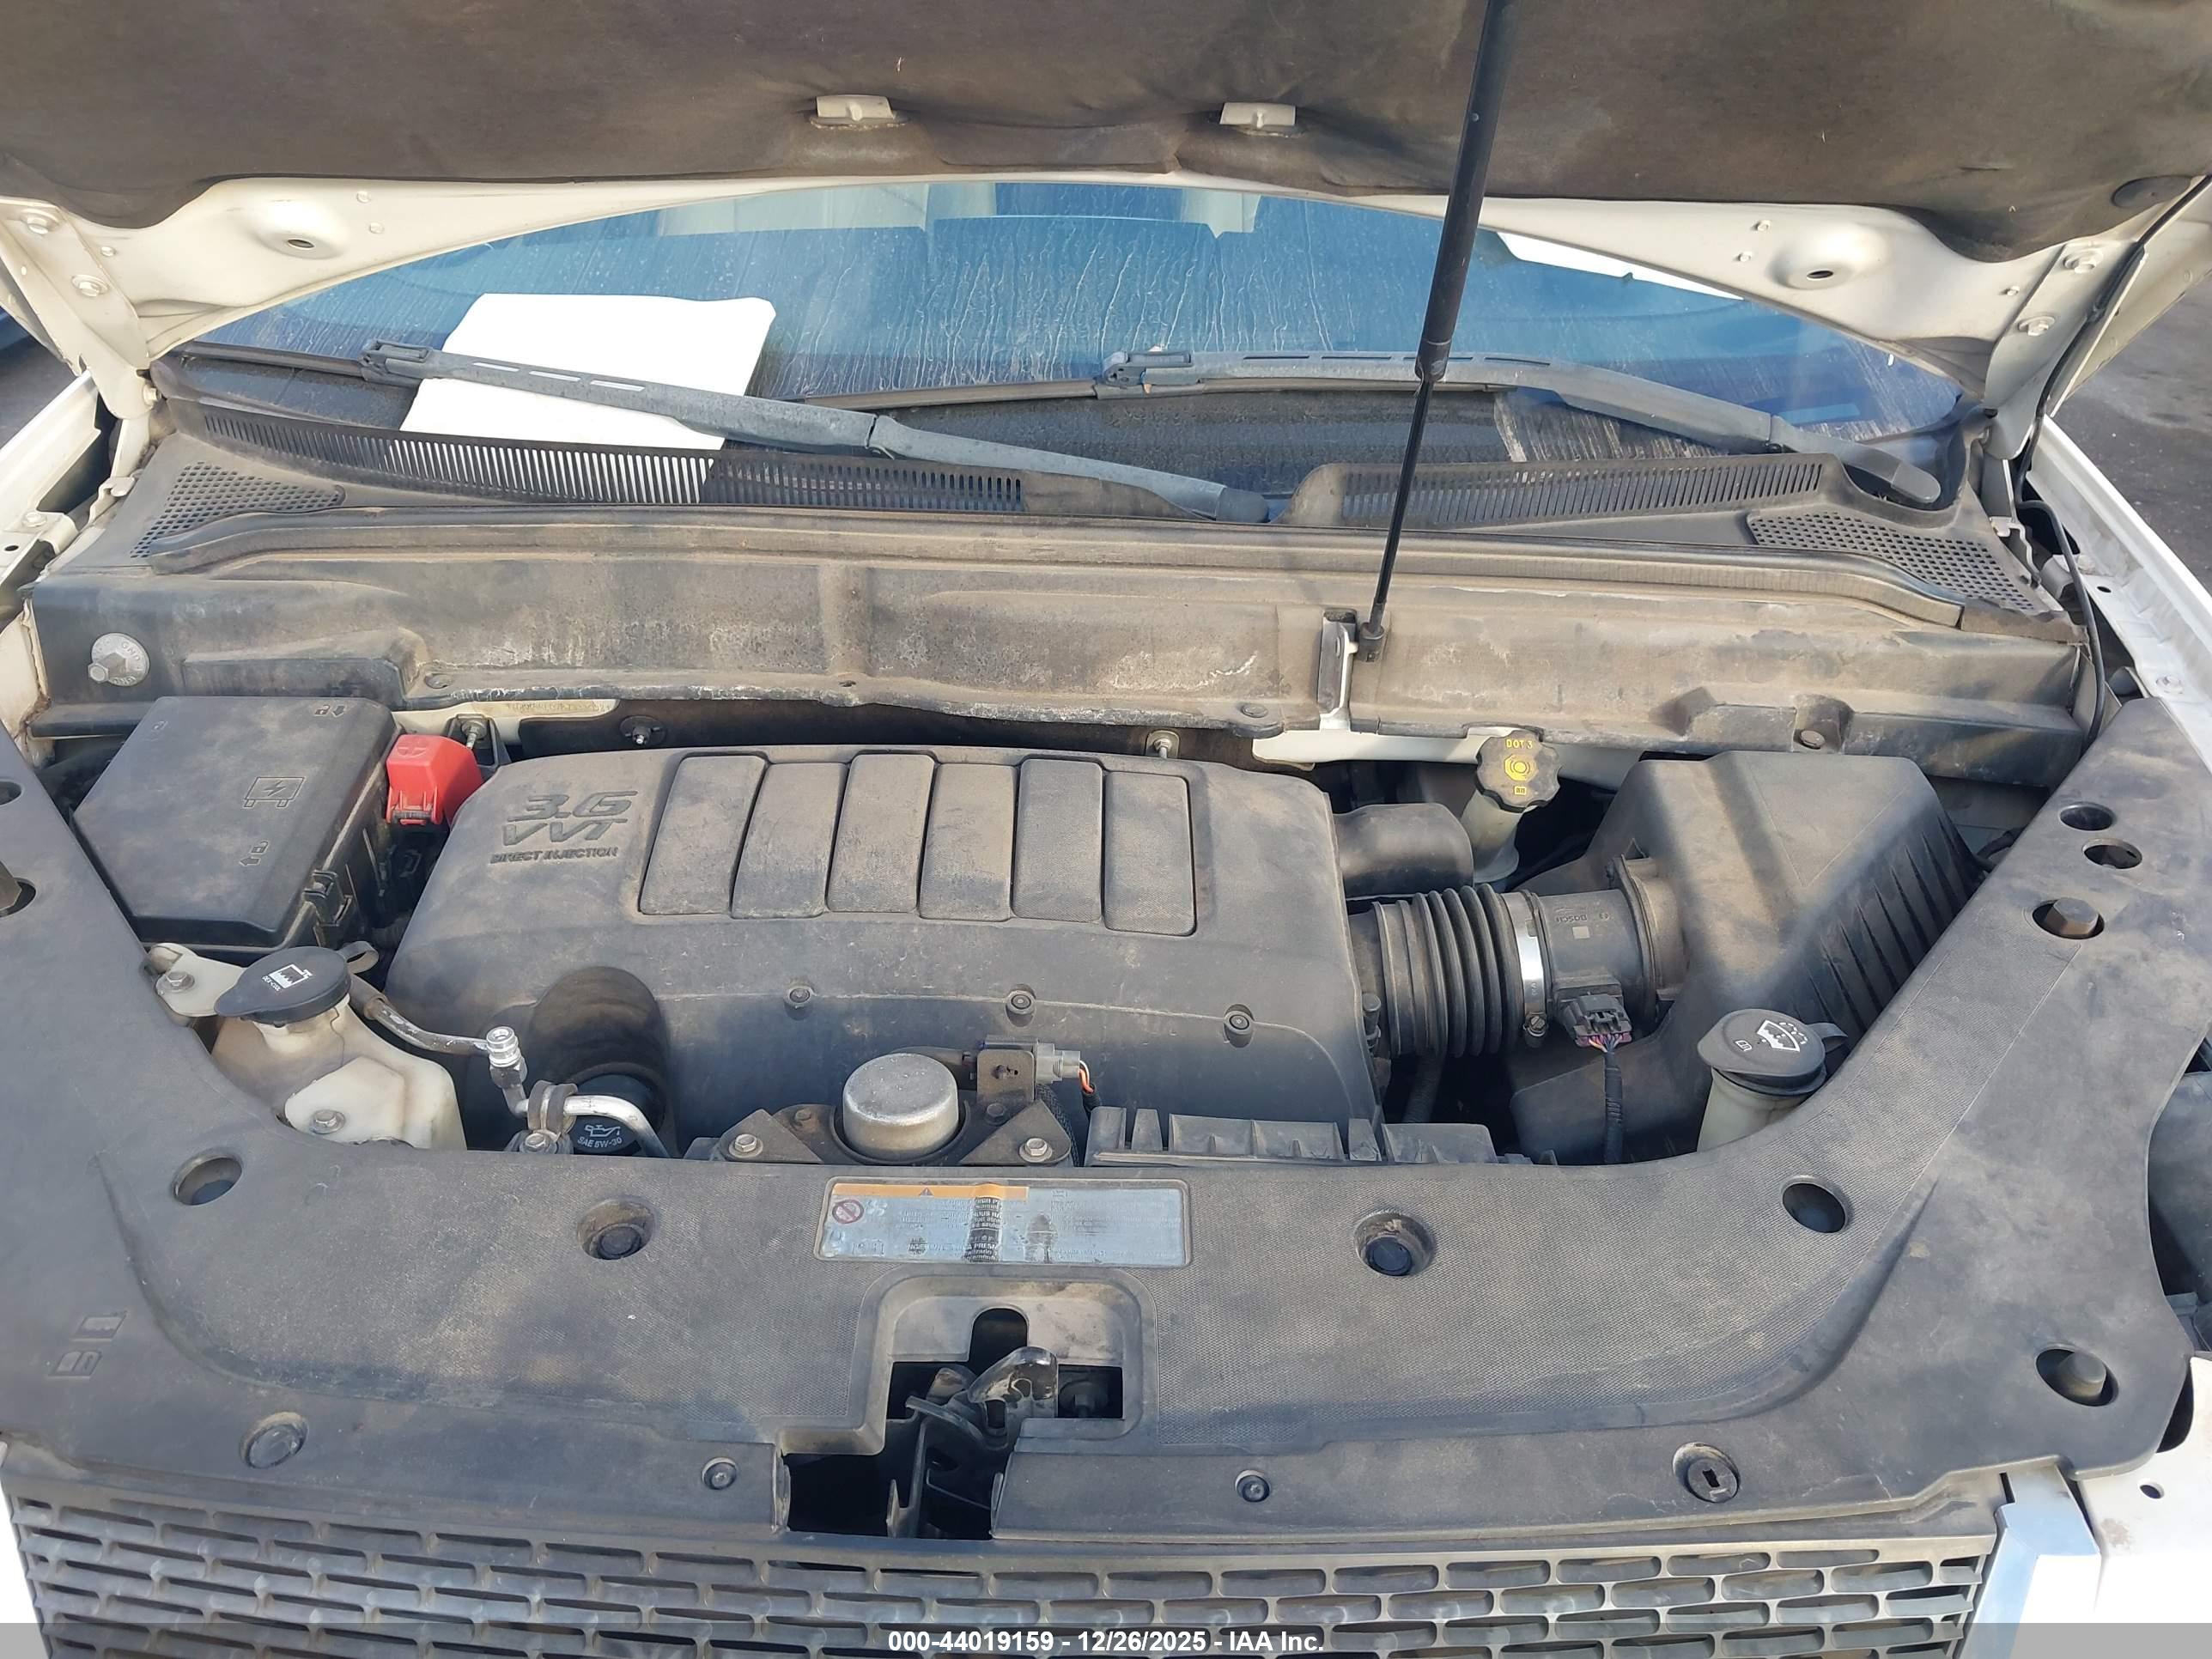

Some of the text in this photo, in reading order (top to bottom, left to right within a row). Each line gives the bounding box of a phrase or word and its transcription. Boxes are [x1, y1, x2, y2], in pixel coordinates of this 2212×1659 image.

[1505, 738, 1533, 749] DOT 3
[507, 791, 638, 822] 3.6
[503, 818, 628, 846] VVT
[489, 847, 618, 864] DIRECT INJECTION
[578, 1136, 623, 1148] SAE 5W-30
